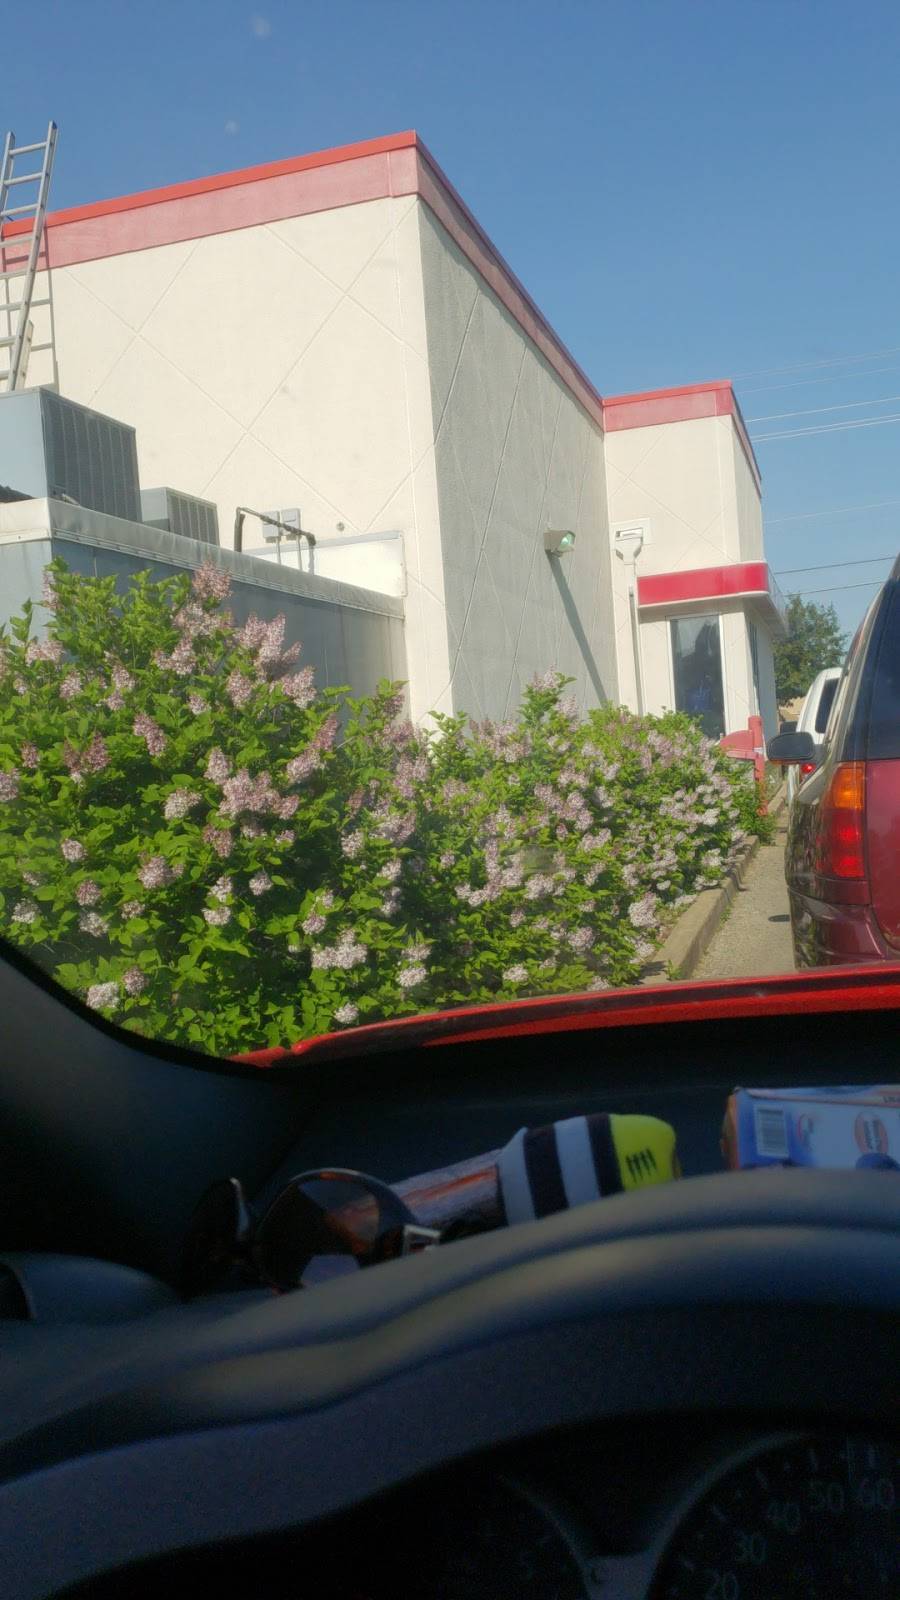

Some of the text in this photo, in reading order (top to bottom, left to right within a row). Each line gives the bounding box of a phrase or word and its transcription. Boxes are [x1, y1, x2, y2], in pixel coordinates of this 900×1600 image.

[808, 1479, 845, 1513] 50
[857, 1477, 896, 1510] 60
[764, 1500, 801, 1535] 40
[732, 1528, 767, 1564] 30
